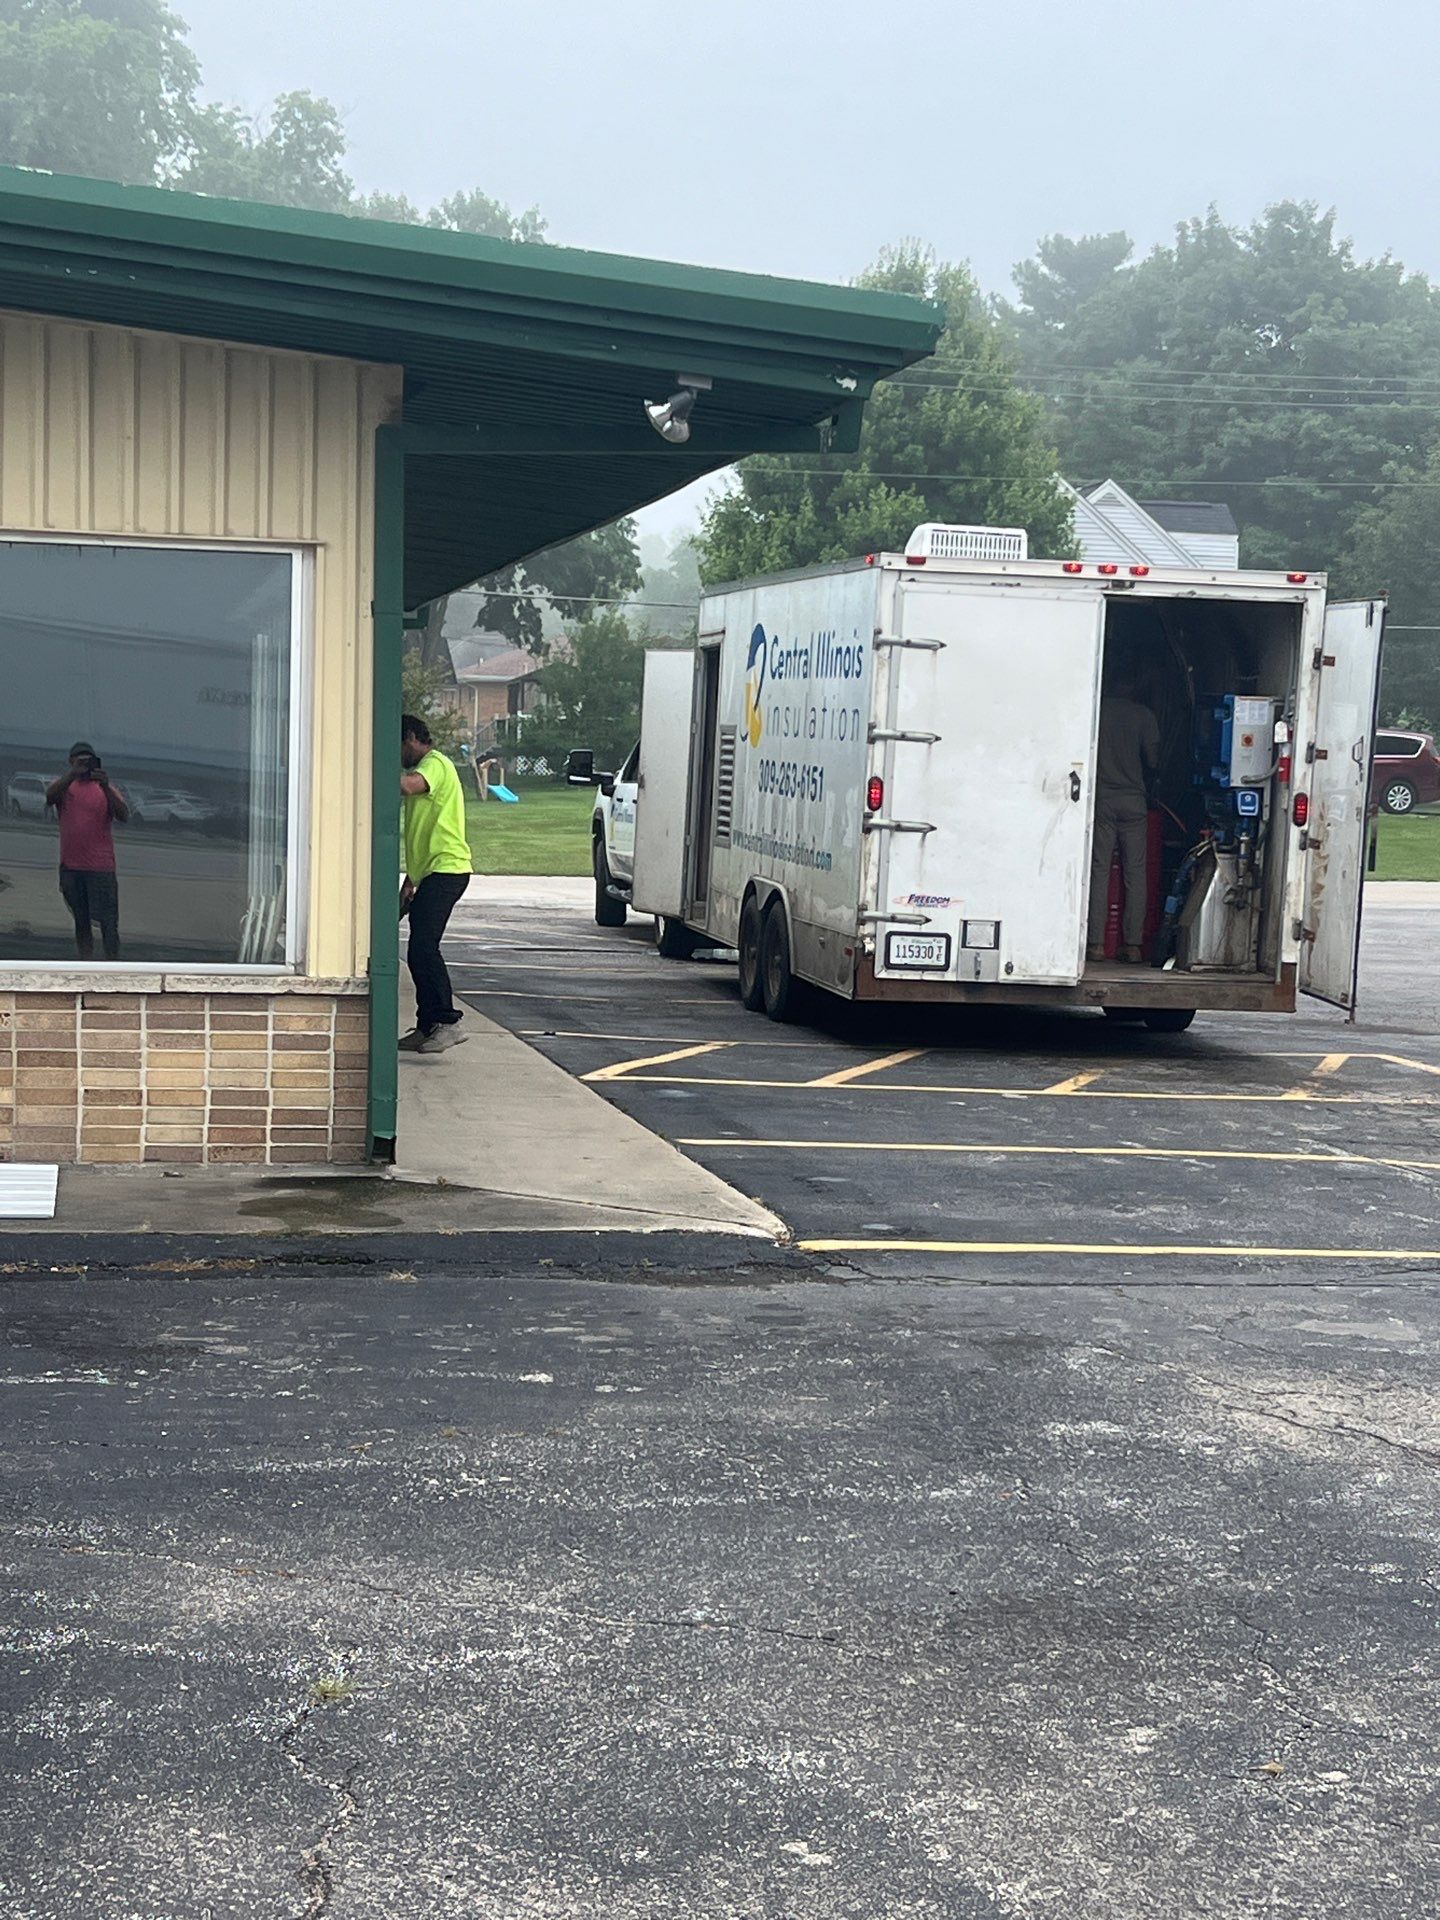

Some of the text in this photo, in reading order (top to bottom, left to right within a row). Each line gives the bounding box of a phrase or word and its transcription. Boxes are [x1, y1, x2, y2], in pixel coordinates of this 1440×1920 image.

[770, 628, 863, 680] Central Illinois
[766, 692, 860, 741] insulation
[758, 758, 824, 802] 309-263-6151
[895, 944, 934, 959] 115330
